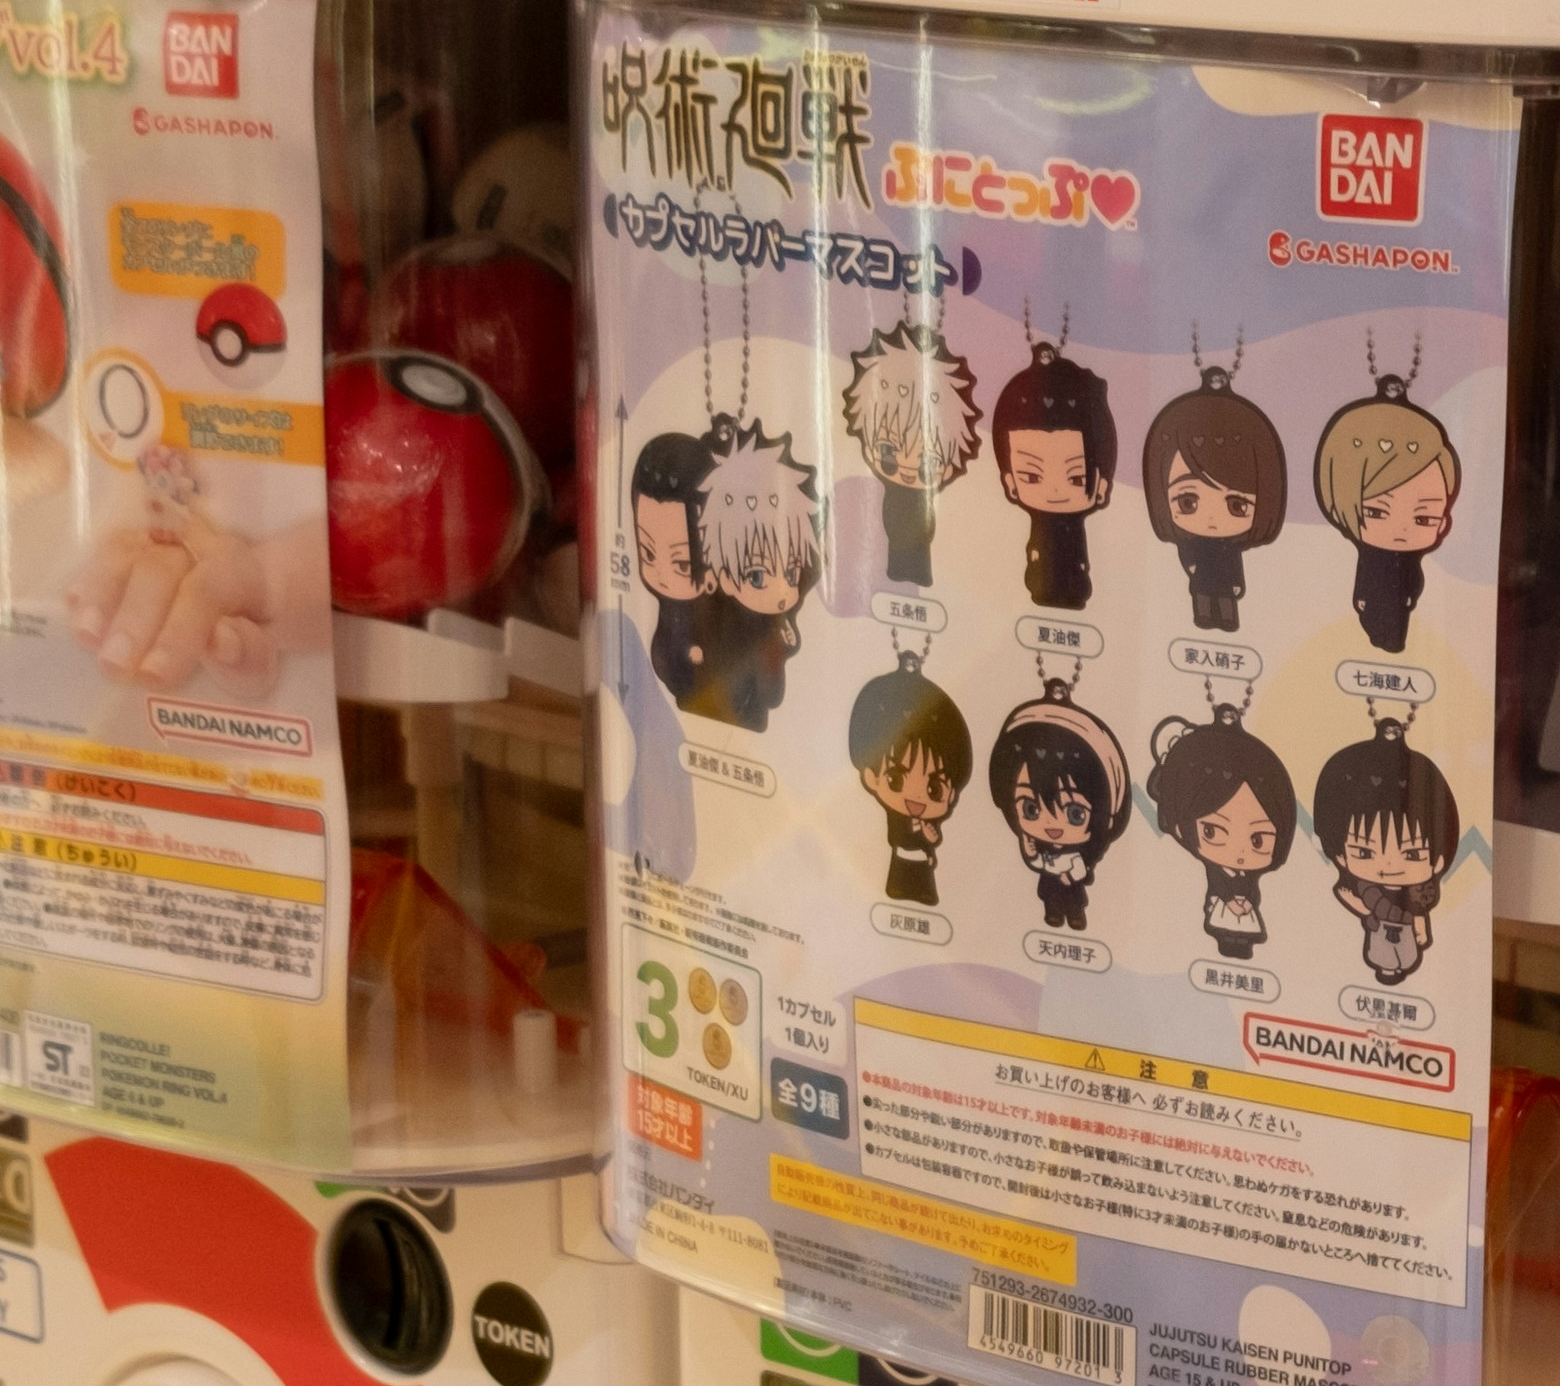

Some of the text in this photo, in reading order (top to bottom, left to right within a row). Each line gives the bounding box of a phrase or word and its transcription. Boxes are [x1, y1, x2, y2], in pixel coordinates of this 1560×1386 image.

[169, 23, 233, 57] BAN
[169, 55, 219, 88] DAI
[152, 112, 275, 142] GASHAPON
[602, 40, 874, 211] 呪術廻戦
[1330, 129, 1414, 171] BAN
[1330, 167, 1395, 205] DAI
[621, 192, 958, 293] カプセルラバーマスコット
[1295, 235, 1453, 273] GASHAPON
[889, 600, 928, 624] 五条悟
[1037, 625, 1082, 649] 夏油傑
[1183, 647, 1247, 672] 家入硝子
[1351, 669, 1419, 695] 七海建人
[157, 708, 303, 746] BANDAI NAMCO
[888, 913, 932, 936] 灰原雄
[1037, 938, 1098, 965] 天内理子
[1202, 966, 1265, 996] 黒井美里
[636, 960, 679, 1058] 3
[777, 996, 836, 1027] 1カプセル
[785, 1026, 829, 1054] 1個入り
[1254, 1024, 1444, 1081] BANDAI NAMCO
[687, 1066, 749, 1102] TOKEN/XU
[778, 1078, 841, 1121] 全9種
[994, 1063, 1302, 1139] お買い上げのお客様へ 必ずお読みください。
[972, 1267, 1134, 1323] 751293-2674932-300
[473, 1314, 552, 1360] TOKEN
[1148, 1323, 1352, 1376] JUJUTSU KAISEN PUNITOP
[1149, 1344, 1221, 1371] CAPSULE
[1224, 1362, 1289, 1385] RUBBER
